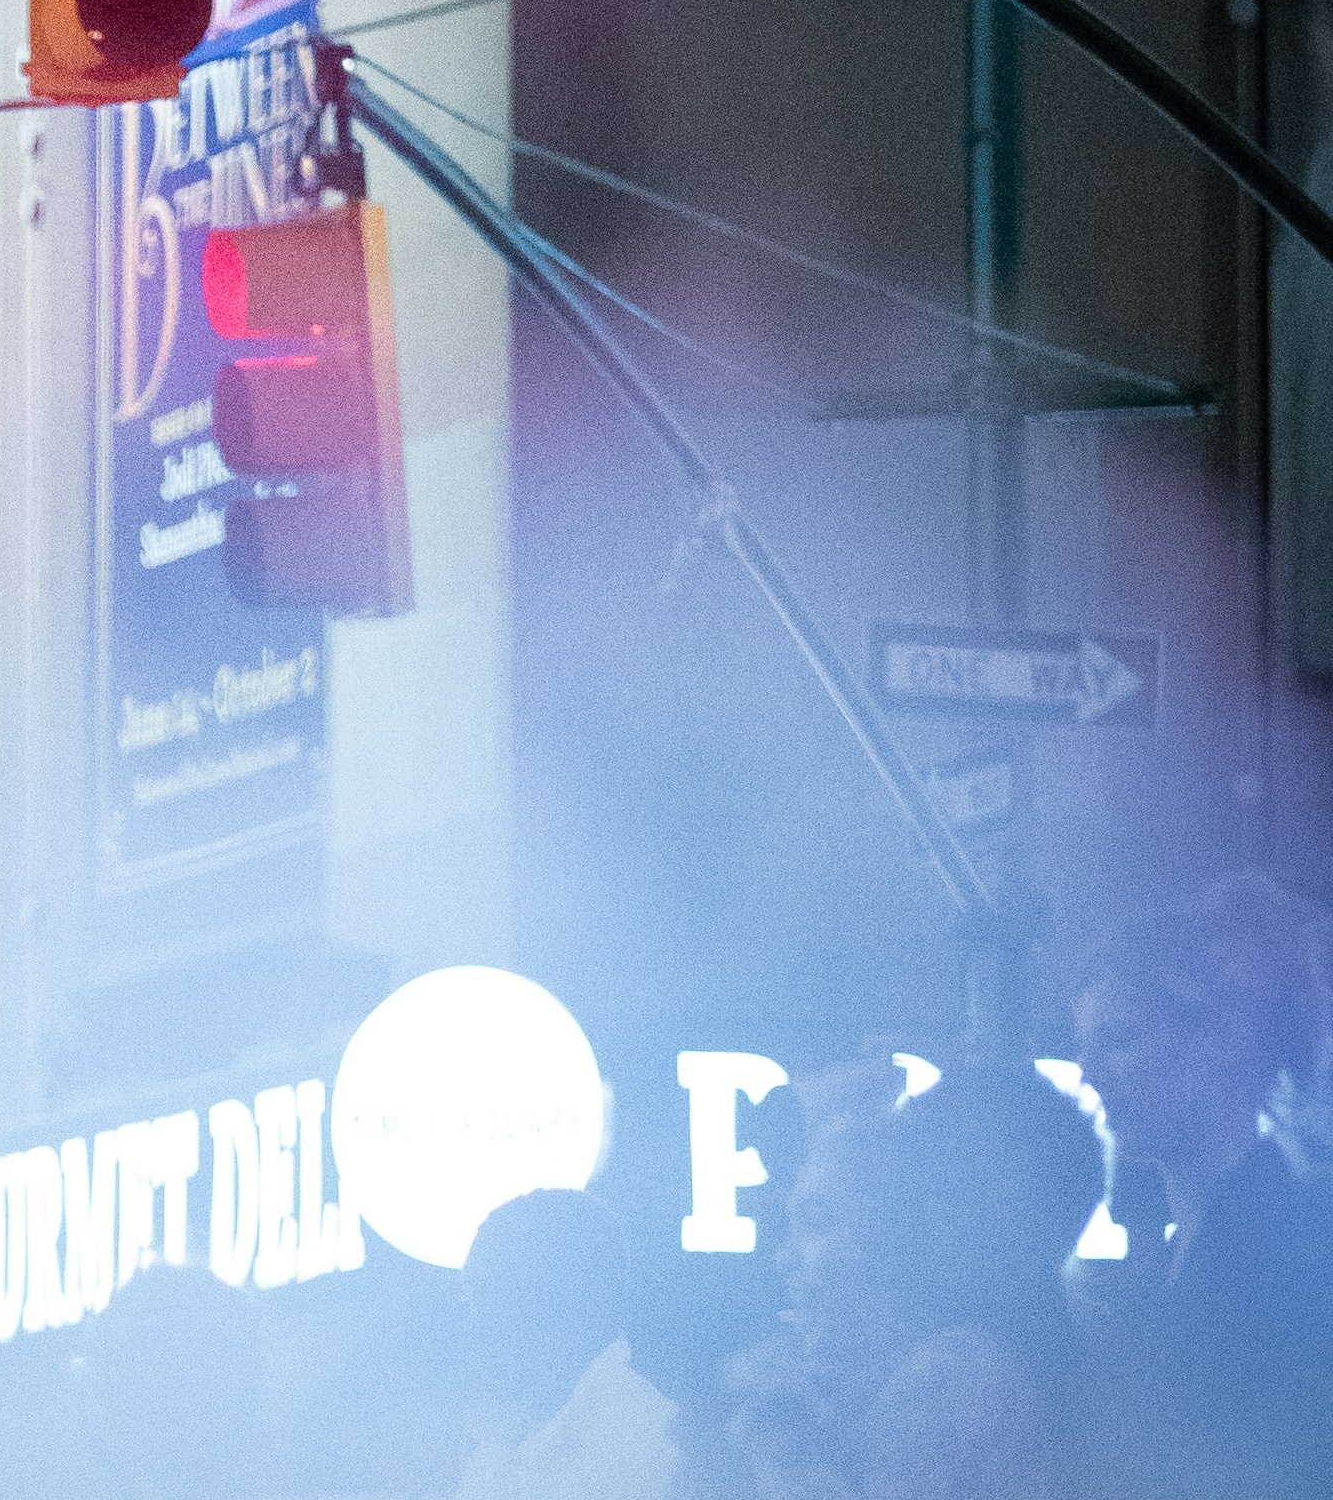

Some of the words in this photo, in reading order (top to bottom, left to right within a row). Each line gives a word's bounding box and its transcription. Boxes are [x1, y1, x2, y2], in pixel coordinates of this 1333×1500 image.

[213, 647, 298, 724] October
[908, 648, 989, 695] ONE
[1032, 653, 1113, 703] WAY
